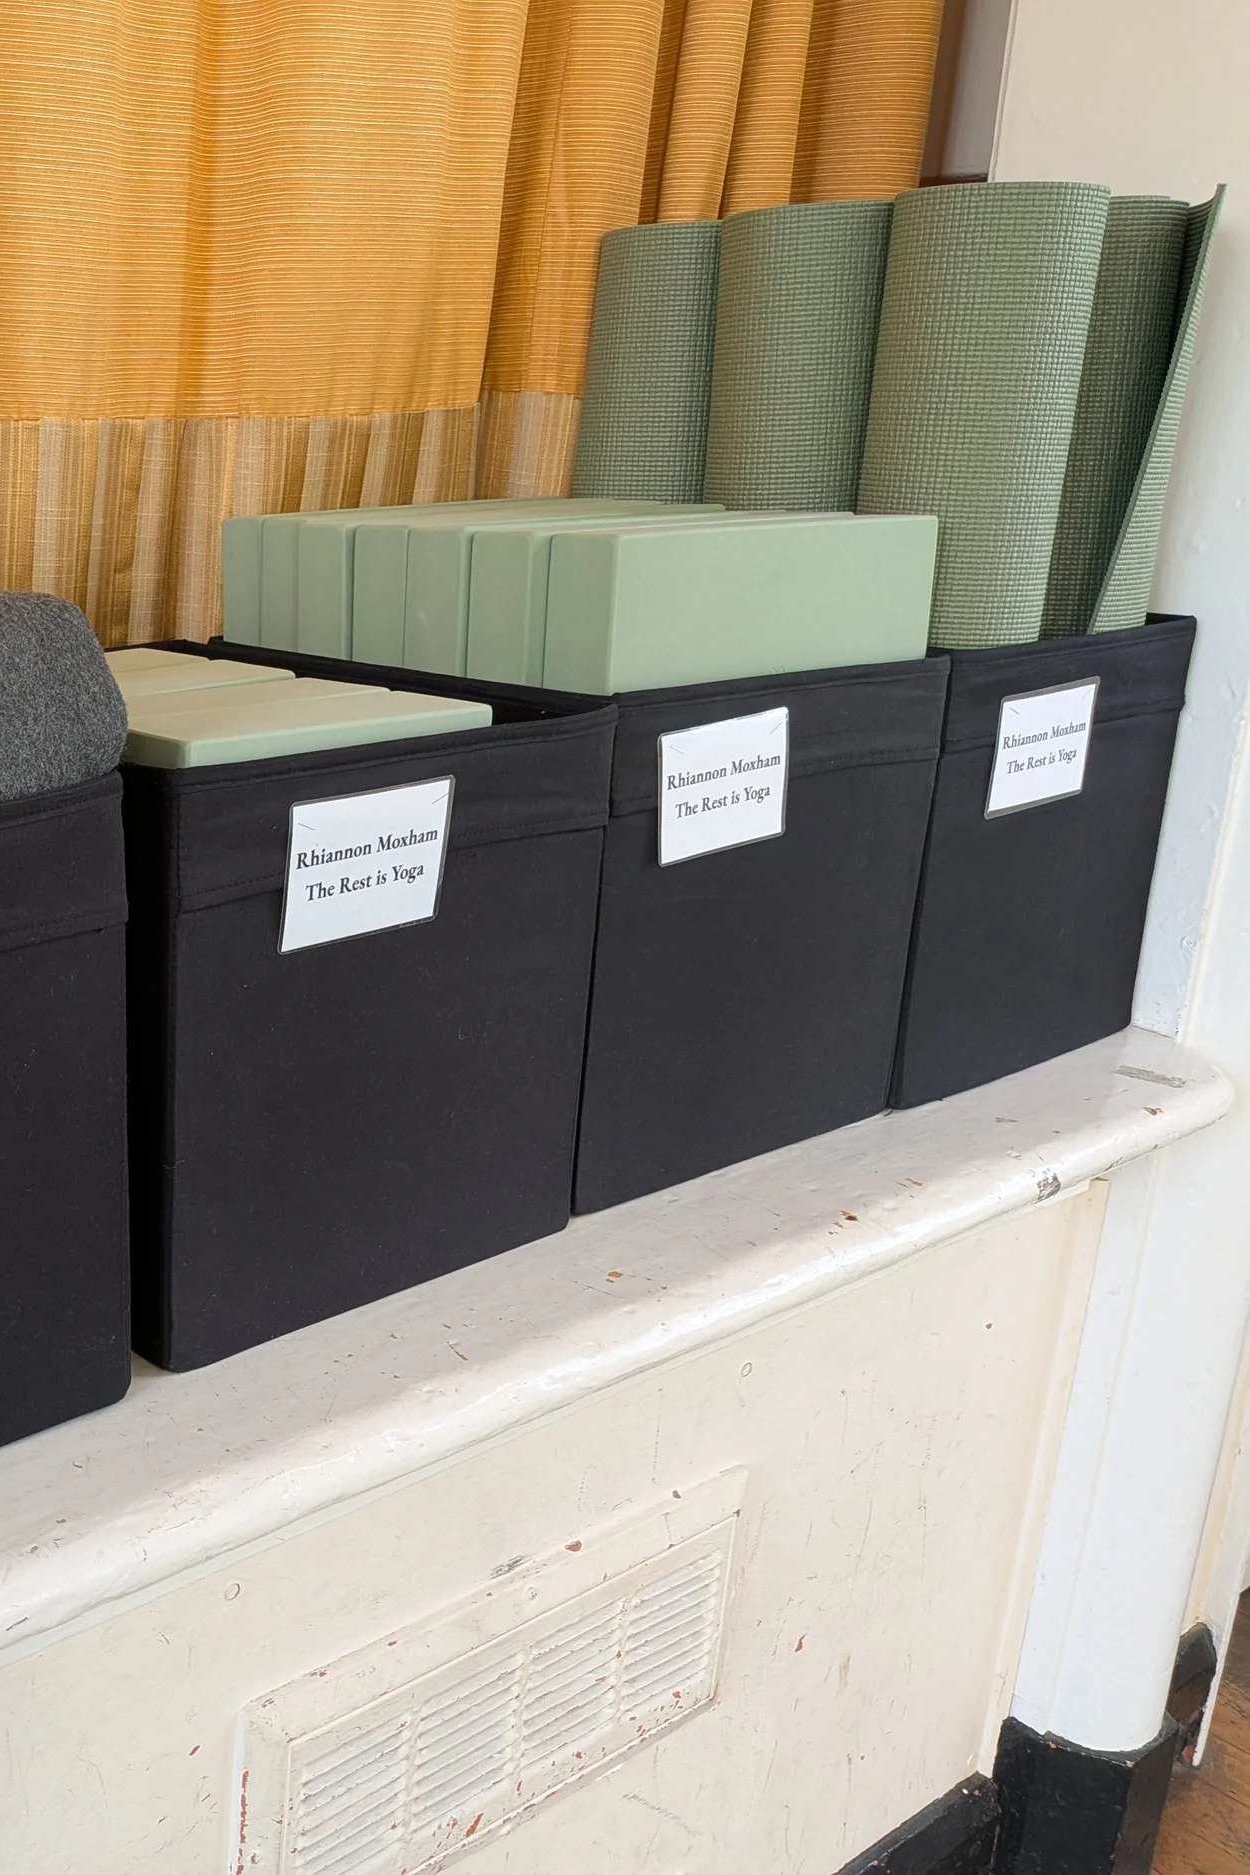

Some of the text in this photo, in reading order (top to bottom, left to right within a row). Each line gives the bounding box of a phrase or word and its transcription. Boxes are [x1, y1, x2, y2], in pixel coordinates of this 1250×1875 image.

[1002, 722, 1086, 749] Rhiannon Moxham
[667, 755, 780, 790] Rhiannon Moxham
[1007, 748, 1076, 774] The Rest is Yoga
[675, 786, 770, 818] The Rest is Yoga
[296, 829, 438, 869] Rhiannon Moxham
[306, 865, 424, 901] The Rest is Yoga
